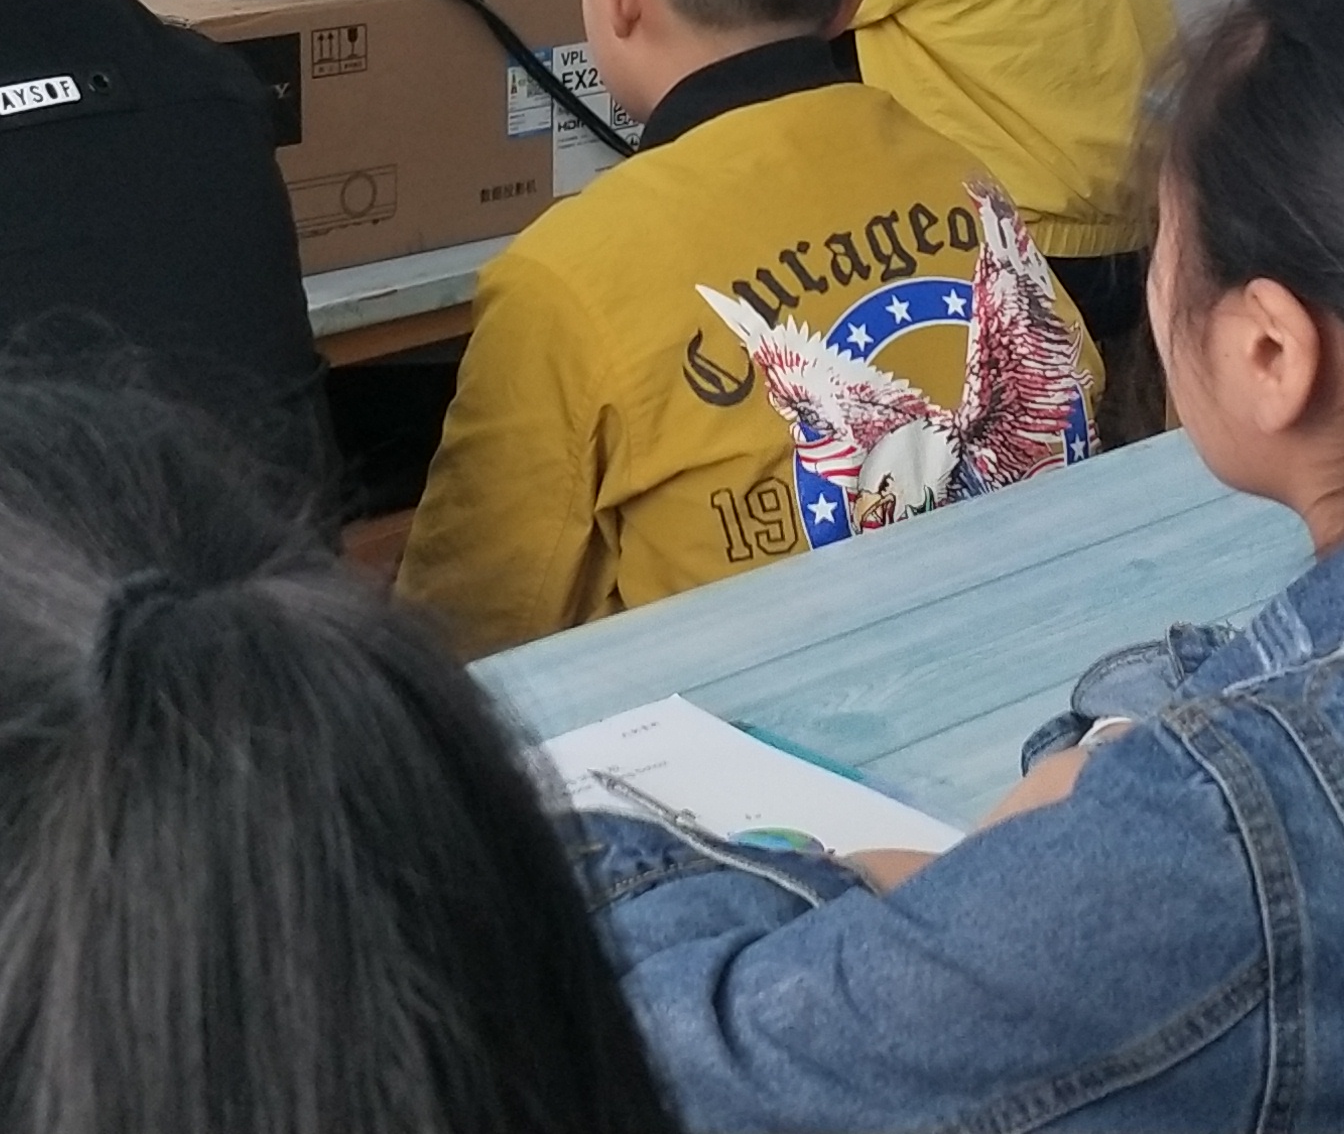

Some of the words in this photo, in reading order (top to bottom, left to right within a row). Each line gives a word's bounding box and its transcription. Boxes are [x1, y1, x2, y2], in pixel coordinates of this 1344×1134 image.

[561, 50, 587, 66] VPL
[562, 67, 604, 92] EX2
[711, 476, 798, 563] 19
